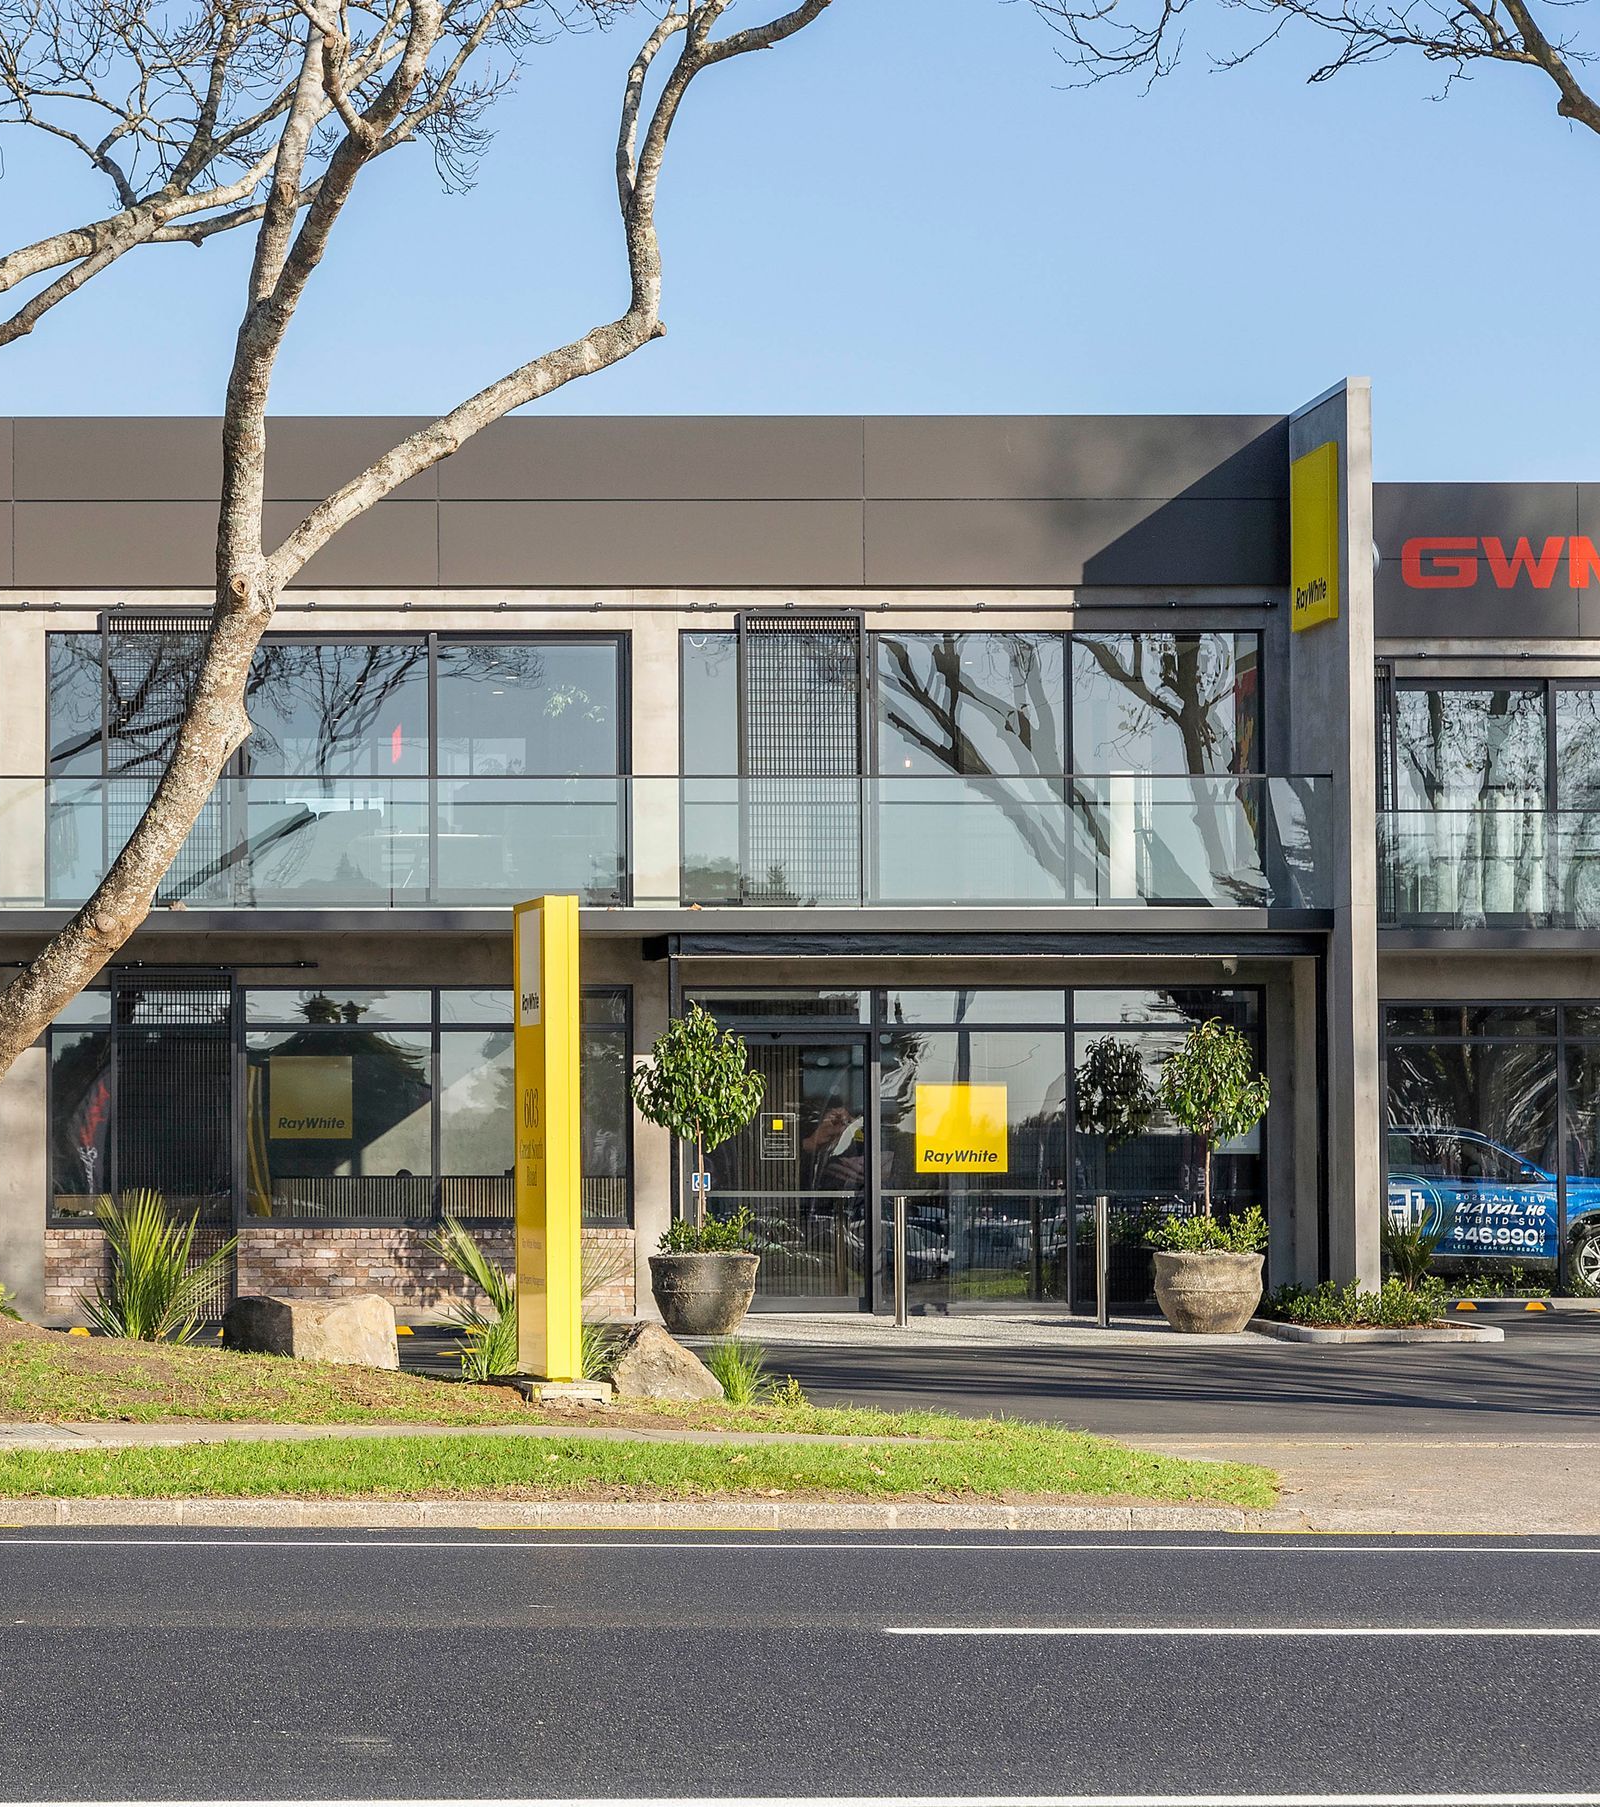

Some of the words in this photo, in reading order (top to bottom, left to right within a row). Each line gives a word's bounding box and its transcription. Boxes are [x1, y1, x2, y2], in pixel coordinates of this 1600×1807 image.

[523, 1087, 539, 1129] 603
[1455, 1202, 1523, 1216] HAVAL
[1525, 1204, 1547, 1216] H6
[1454, 1215, 1509, 1225] HYBRID
[1518, 1217, 1546, 1226] SUV
[1453, 1225, 1539, 1246] $46,990
